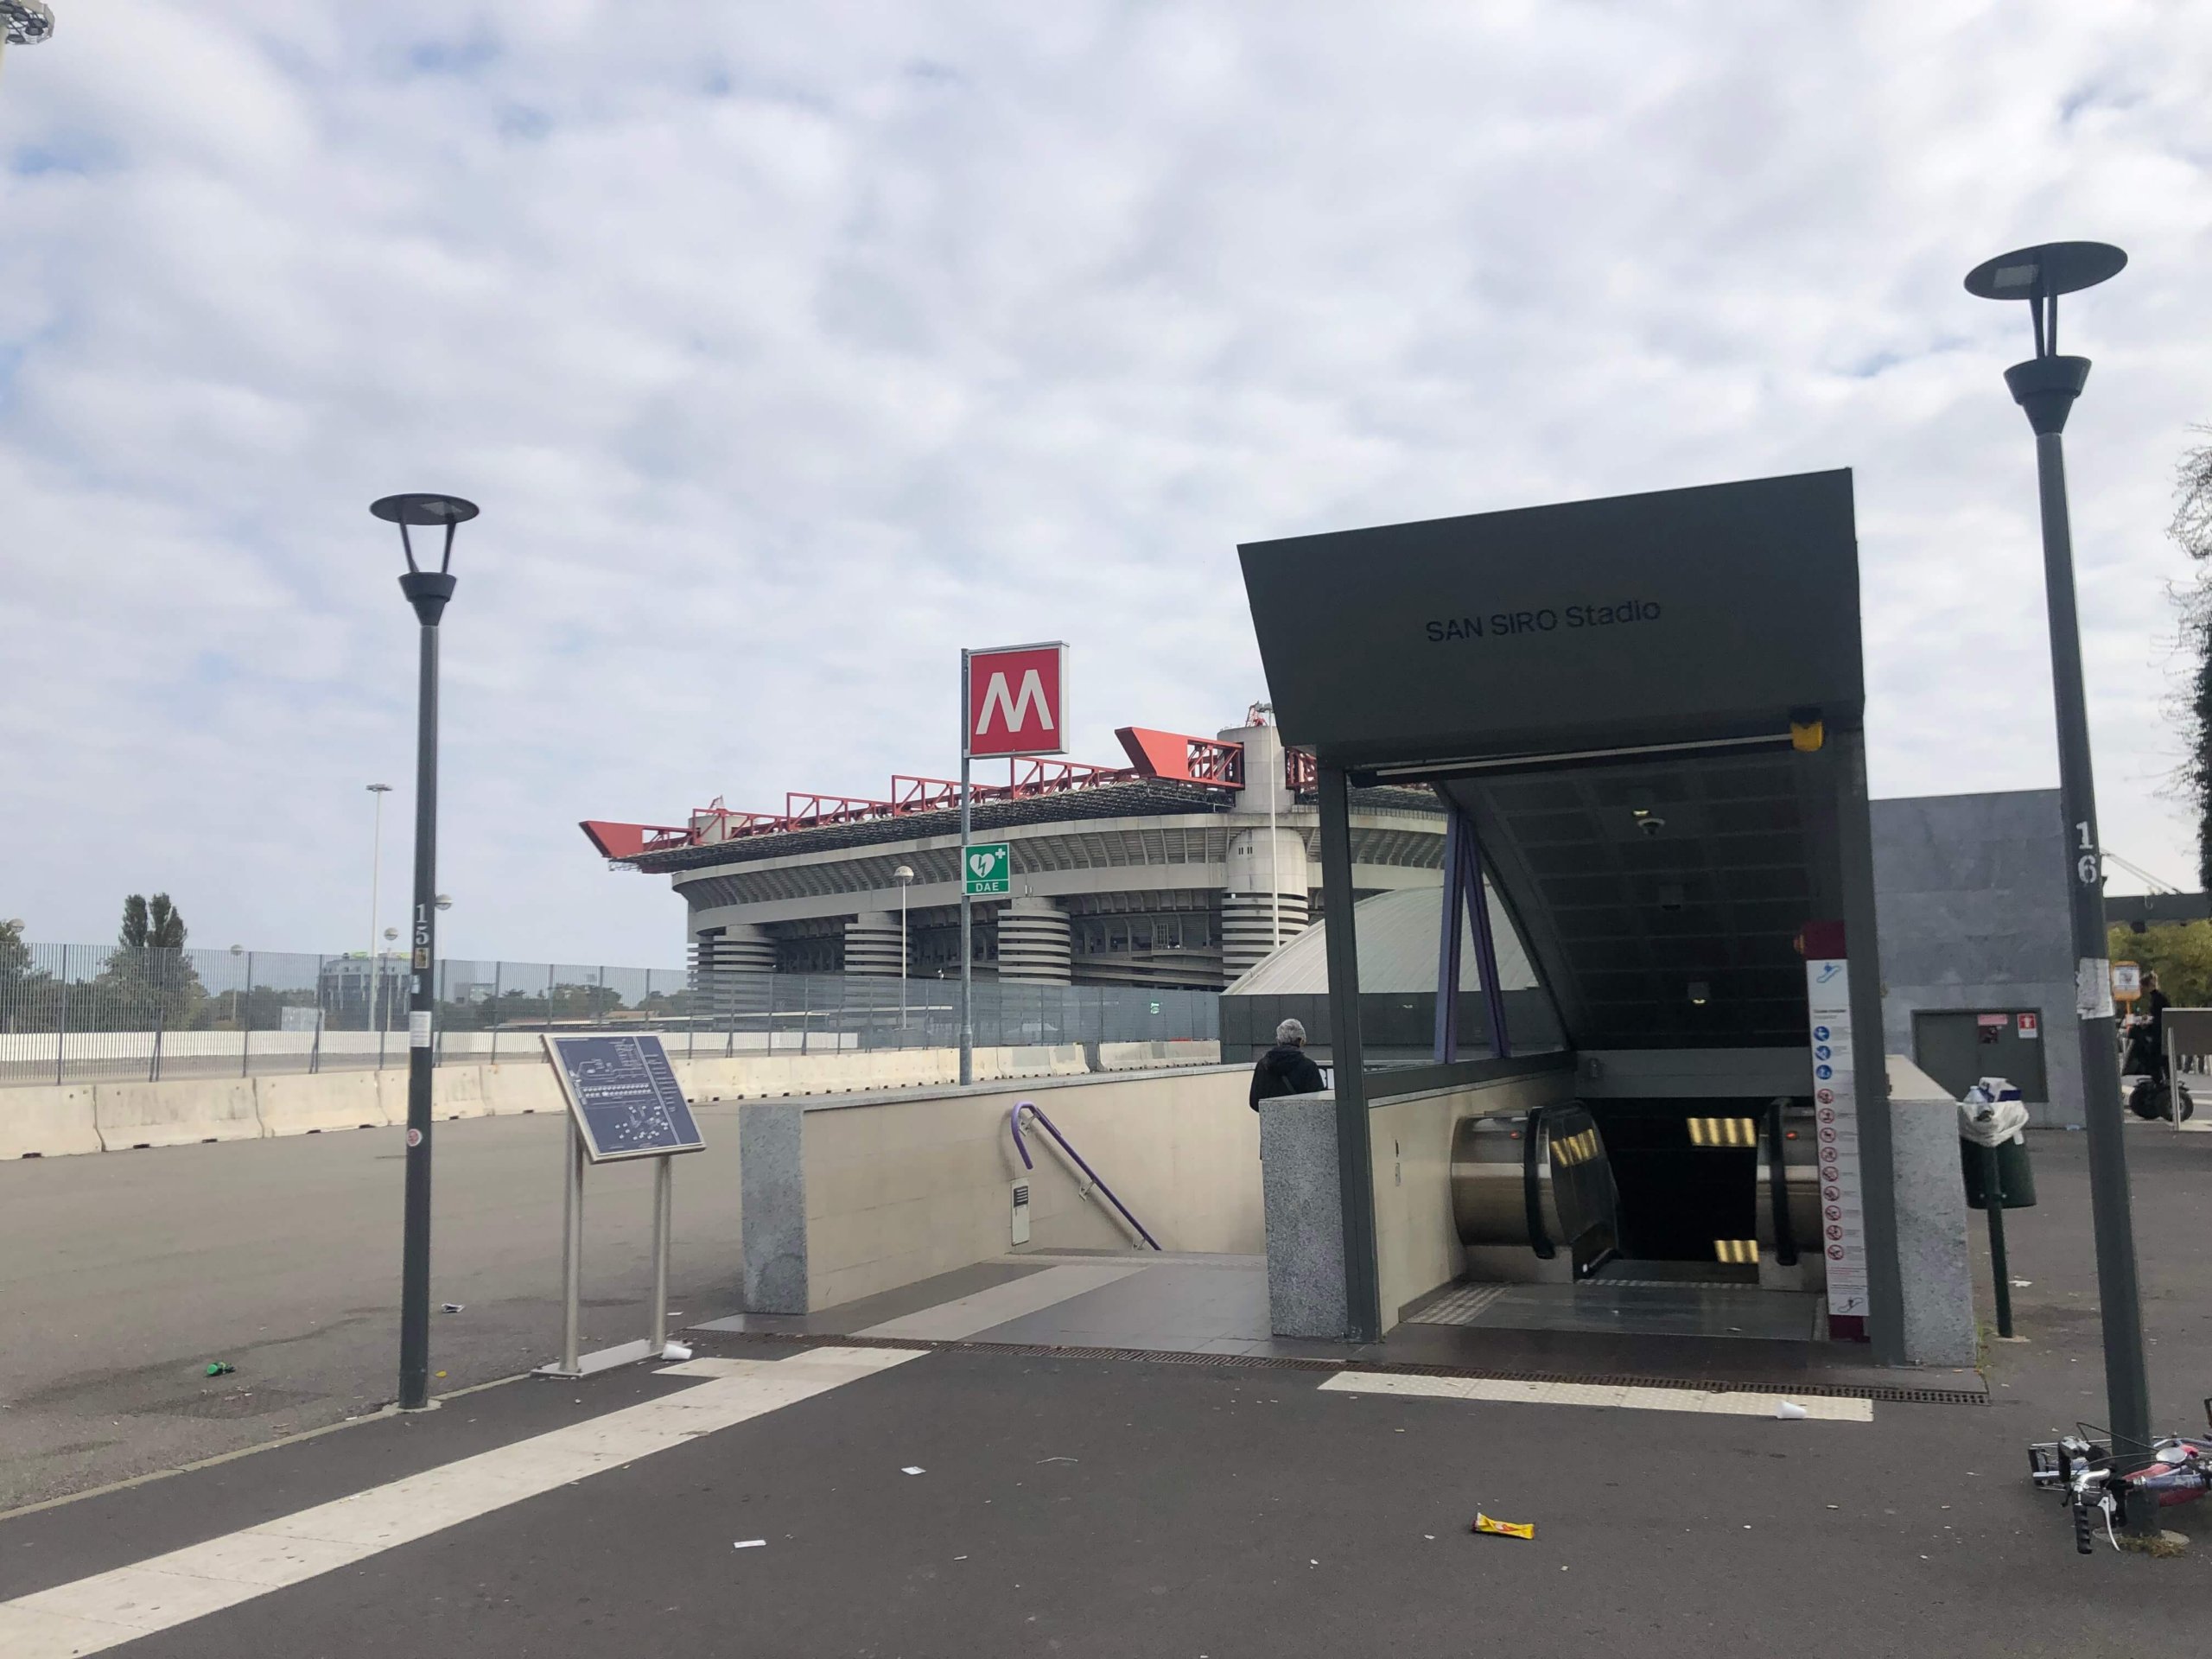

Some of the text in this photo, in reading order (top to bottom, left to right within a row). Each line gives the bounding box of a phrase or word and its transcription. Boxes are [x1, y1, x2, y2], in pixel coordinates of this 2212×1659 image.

[1427, 600, 1662, 642] SAN SIRO Stadio
[976, 669, 1055, 735] M
[2075, 821, 2097, 884] 16
[975, 881, 1000, 893] DAE
[415, 903, 430, 945] 15
